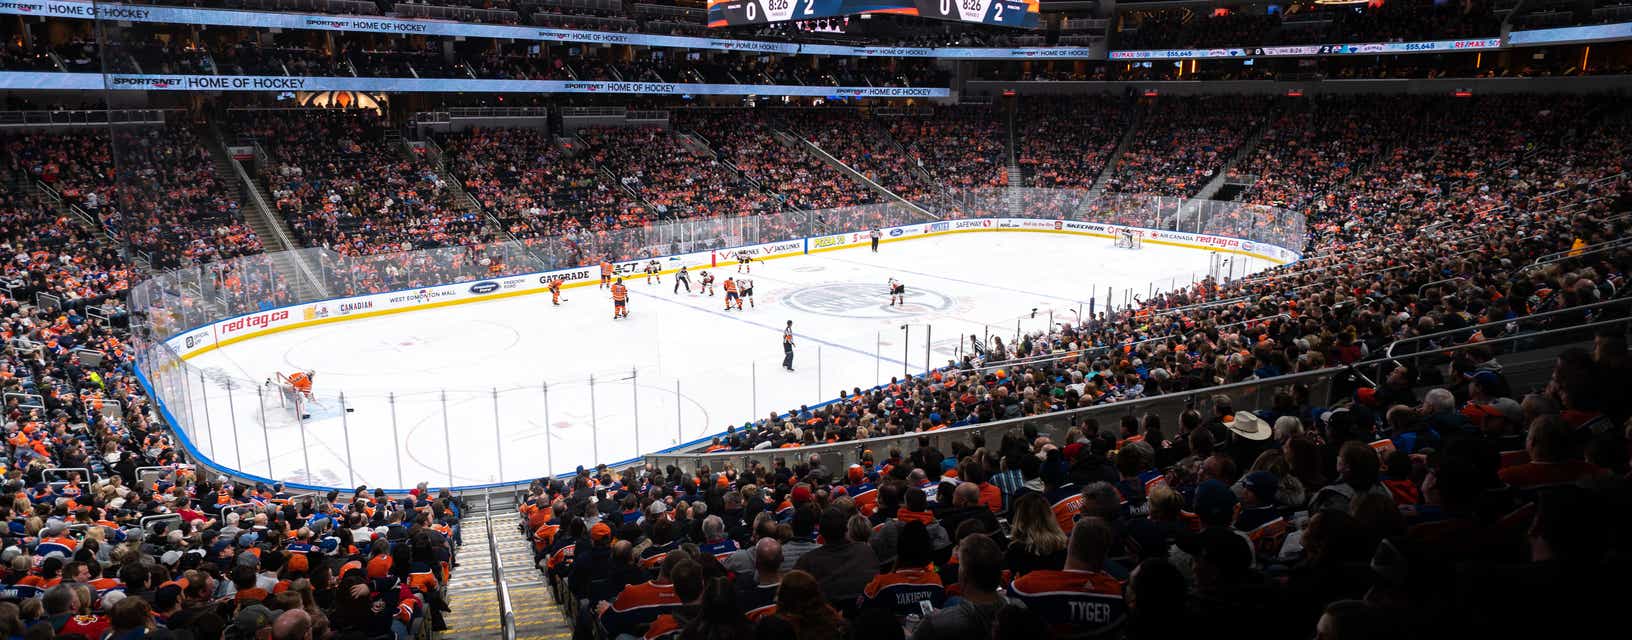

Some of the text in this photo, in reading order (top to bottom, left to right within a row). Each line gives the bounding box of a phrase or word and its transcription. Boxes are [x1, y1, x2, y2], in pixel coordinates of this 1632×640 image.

[746, 2, 756, 20] 0
[768, 0, 789, 11] 8:26
[804, 0, 814, 15] 2
[49, 4, 83, 15] HOME
[87, 6, 101, 16] OF
[104, 7, 150, 19] HOCKEY
[994, 3, 1004, 21] 2
[353, 22, 379, 30] HOME
[381, 22, 392, 30] OF
[394, 23, 426, 32] HOCKEY
[572, 33, 592, 41] HOME
[602, 34, 628, 42] HOCKEY
[1454, 40, 1485, 49] RE/MAX
[113, 77, 306, 90] SPORTSNET HOME OF HOCKEY
[607, 83, 631, 92] HOME
[633, 83, 643, 92] OF
[644, 84, 676, 93] HOCKEY
[955, 221, 982, 229] SAFEWAY
[1066, 223, 1105, 232] SKECHERS
[814, 237, 835, 248] PIZZA
[1169, 234, 1193, 242] CANADA
[539, 270, 590, 284] GATORADE
[406, 292, 441, 301] EDMONTON
[340, 300, 374, 312] CANADIAN
[1067, 601, 1111, 624] TYGER
